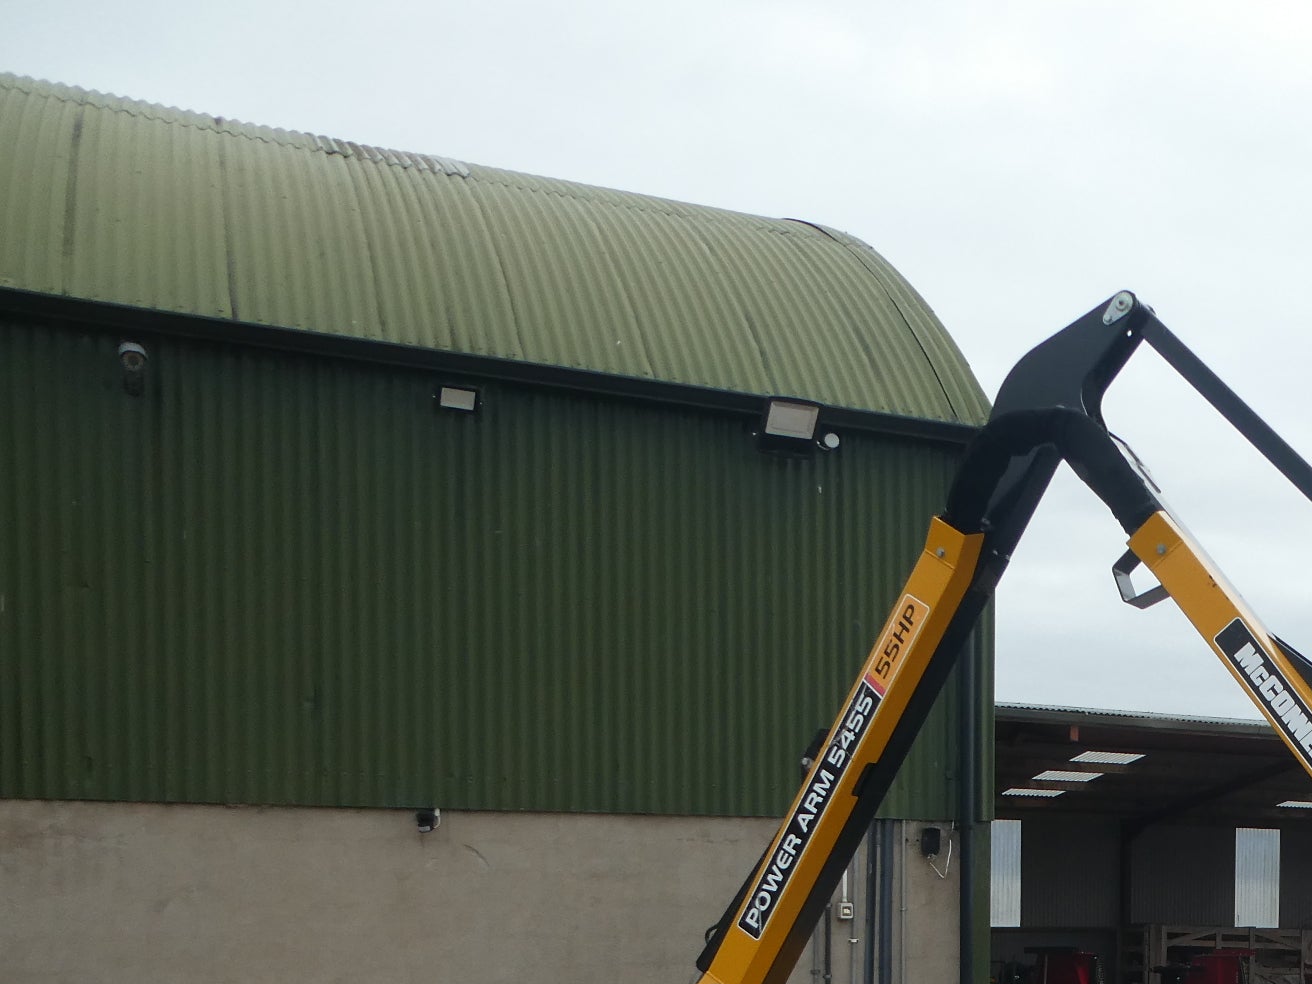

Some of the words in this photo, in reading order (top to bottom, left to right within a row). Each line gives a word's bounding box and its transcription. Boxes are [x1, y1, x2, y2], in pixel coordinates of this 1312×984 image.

[744, 834, 802, 930] POWER
[798, 768, 835, 833] ARM
[827, 692, 873, 768] 5455
[874, 604, 916, 680] 55HP
